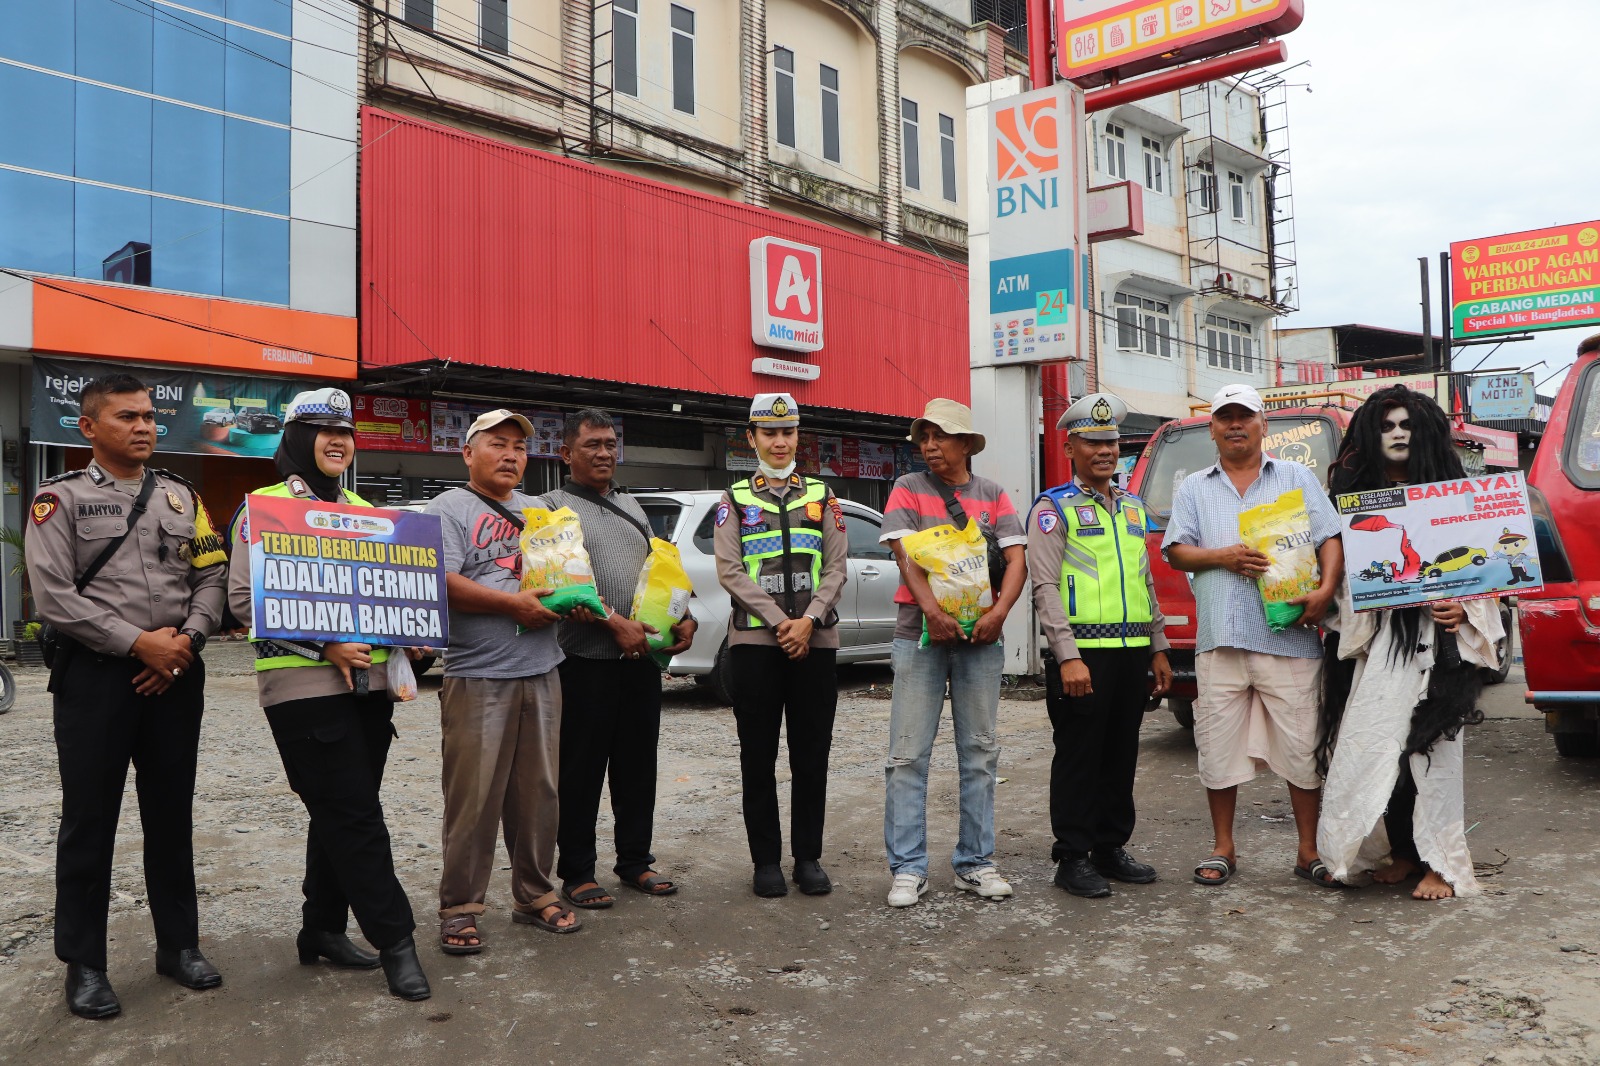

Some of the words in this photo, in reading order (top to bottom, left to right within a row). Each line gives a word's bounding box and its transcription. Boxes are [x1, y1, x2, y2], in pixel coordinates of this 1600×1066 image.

[1142, 14, 1156, 23] ATM
[1176, 20, 1193, 28] PULSA
[996, 176, 1058, 218] BNI
[1496, 243, 1522, 254] BUKA
[1524, 242, 1537, 250] 24
[1538, 238, 1560, 248] JAM
[1462, 256, 1540, 280] WARKOP
[1546, 248, 1599, 270] AGAM
[996, 274, 1030, 294] ATM
[1470, 267, 1592, 296] PERBAUNGAN
[1038, 290, 1065, 316] 24
[1469, 299, 1534, 316] CABANG
[1537, 290, 1594, 308] MEDAN
[1468, 314, 1506, 329] Special
[1531, 306, 1594, 320] Bangladesh
[769, 323, 819, 344] Alfamidi
[262, 348, 313, 365] PERBAUNGAN
[772, 362, 809, 374] PERBAUNGAN
[46, 374, 94, 396] rejek
[156, 384, 183, 400] BNI
[1488, 377, 1518, 388] KING
[1264, 391, 1308, 410] ANEKA
[1363, 386, 1372, 394] Es
[1404, 381, 1414, 390] Es
[1482, 388, 1523, 400] MOTOR
[374, 398, 408, 412] STOP
[860, 464, 882, 477] 3.000
[1360, 490, 1402, 500] KESELAMATAN
[1407, 474, 1518, 501] BAHAYA!
[1474, 490, 1522, 503] MABUK
[78, 504, 122, 516] MAHYUD
[1340, 495, 1360, 508] OPS
[1474, 501, 1525, 512] SAMBIL
[1430, 507, 1526, 526] BERKENDARA
[261, 532, 318, 557] TERTIB
[321, 537, 385, 563] BERLALU
[389, 544, 437, 568] LINTAS
[1276, 530, 1311, 551] SPHP
[948, 554, 985, 574] SPHP
[265, 560, 353, 594] ADALAH
[358, 567, 438, 601] CERMIN
[265, 598, 355, 633] BUDAYA
[358, 604, 442, 638] BANGSA
